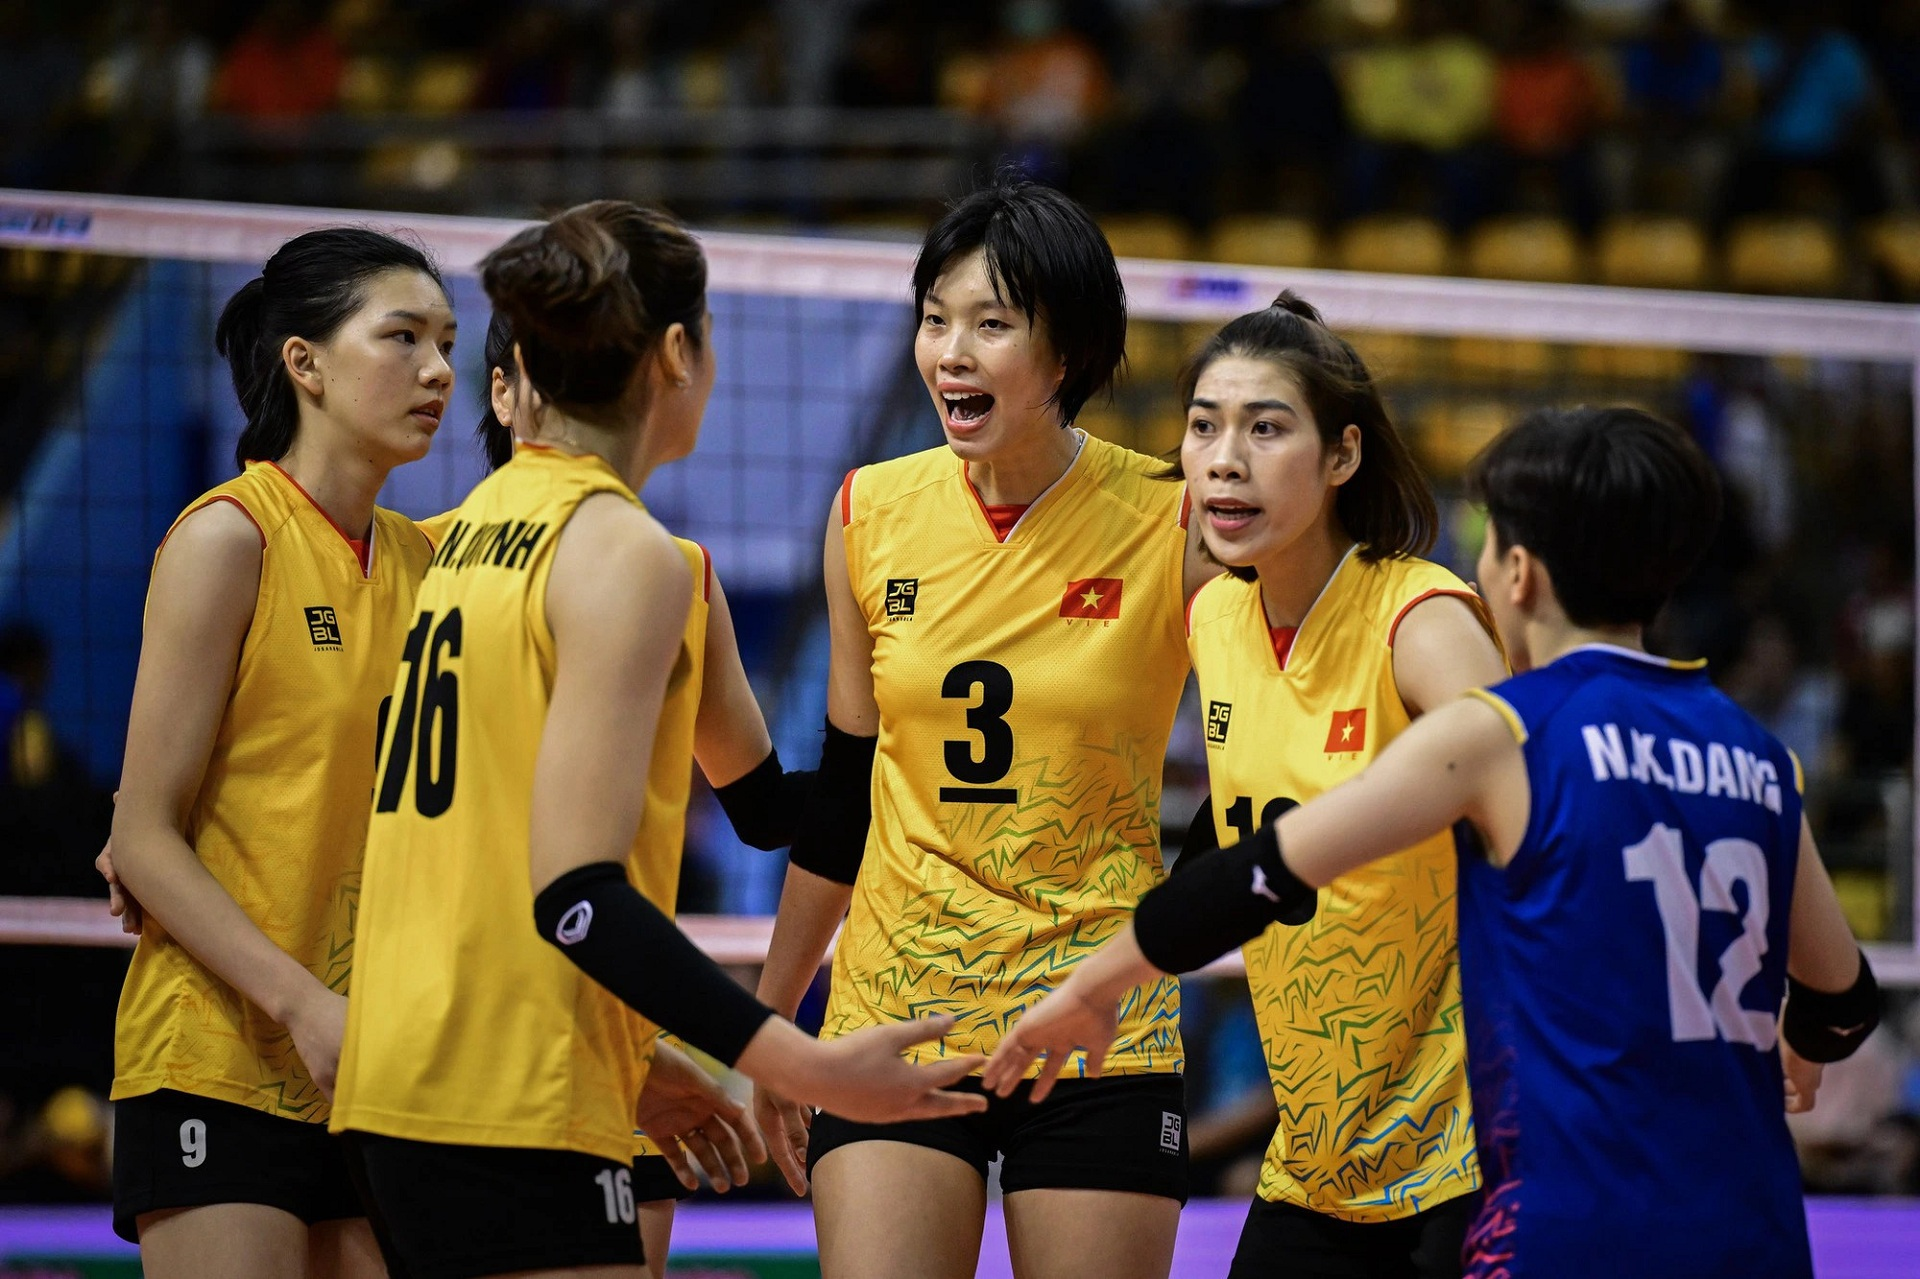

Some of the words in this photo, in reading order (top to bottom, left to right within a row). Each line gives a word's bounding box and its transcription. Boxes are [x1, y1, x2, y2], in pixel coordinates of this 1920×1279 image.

[887, 598, 911, 613] BL
[888, 581, 915, 597] JG
[310, 610, 336, 625] JG
[312, 626, 340, 641] BL
[375, 607, 463, 819] 16
[941, 660, 1014, 785] 3
[1210, 704, 1230, 722] JG
[1622, 822, 1777, 1052] 12
[180, 1118, 207, 1168] 9
[595, 1168, 636, 1224] 16
